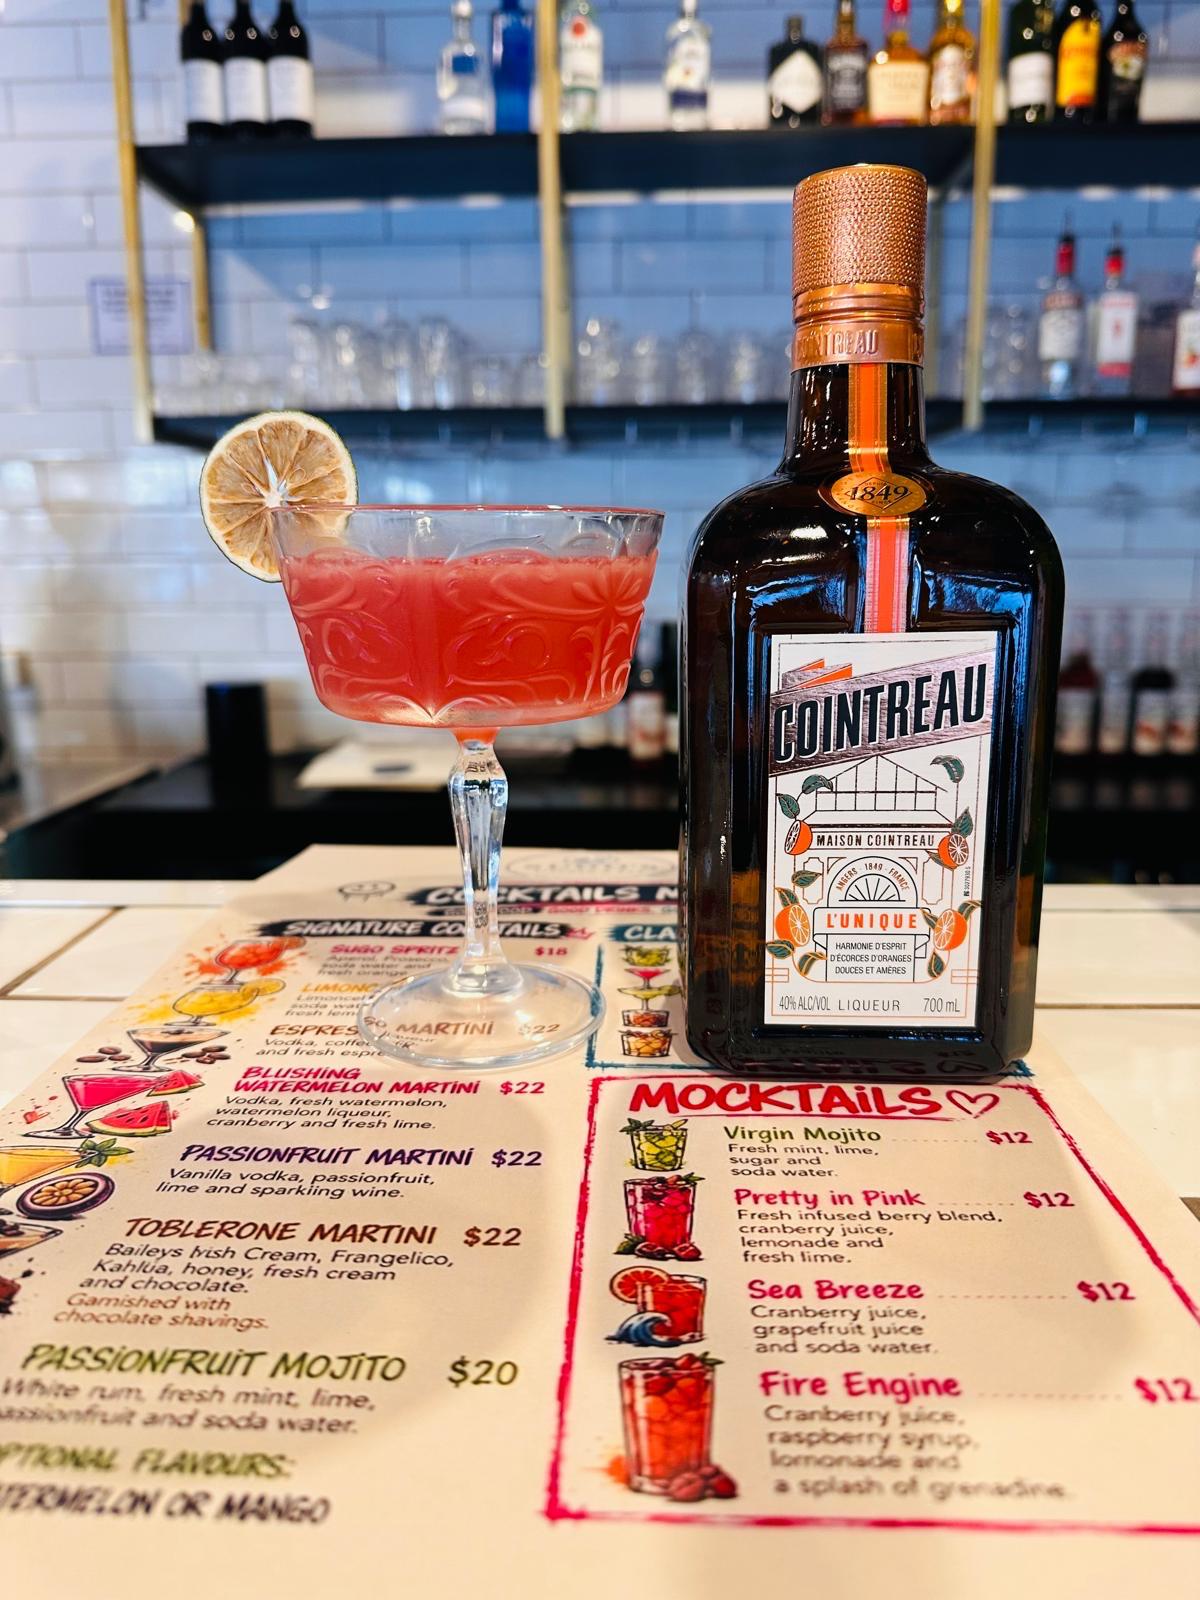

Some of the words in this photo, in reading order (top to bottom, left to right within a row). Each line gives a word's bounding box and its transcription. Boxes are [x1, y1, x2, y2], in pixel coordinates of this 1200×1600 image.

[849, 484, 909, 501] 1849
[773, 663, 987, 763] COINTREAU
[816, 834, 862, 847] MAISON
[867, 834, 935, 847] COINTREAU
[836, 867, 858, 891] ANGERS
[864, 863, 883, 871] 1849
[888, 868, 911, 891] FRANCE
[283, 920, 424, 936] SIGNATURE
[430, 922, 561, 938] COTAILS
[826, 912, 917, 931] L'UNIQUE
[330, 944, 384, 954] SUGO
[390, 944, 460, 955] SPRITZ
[534, 946, 568, 957] $18
[835, 942, 873, 951] HARMONIE
[875, 942, 907, 951] D'ESPRIT
[830, 953, 869, 963] D'ÉCORCES
[870, 954, 912, 963] D'ORANGES
[835, 966, 864, 974] DOUCES
[865, 966, 875, 974] ET
[876, 964, 907, 974] AMÈRES
[302, 983, 380, 993] LIMONC
[779, 996, 797, 1011] 40%
[797, 996, 831, 1011] ALC/VOL
[838, 999, 900, 1012] LIQUEUR
[923, 997, 943, 1012] 700
[945, 998, 960, 1012] mL
[256, 1048, 291, 1056] and
[293, 1048, 336, 1056] fresh
[233, 1080, 384, 1095] WATERMELON
[500, 1081, 545, 1096] $22
[225, 1095, 283, 1108] Vodka,
[289, 1096, 332, 1108] fresh
[336, 1097, 447, 1109] watermelon,
[214, 1107, 322, 1119] watermelon
[327, 1107, 392, 1120] liqueur,
[206, 1117, 295, 1131] cranberry
[301, 1118, 336, 1130] and
[342, 1118, 387, 1130] fresh
[391, 1119, 437, 1131] lime.
[723, 1125, 795, 1145] Virgin
[803, 1126, 882, 1144] Mojito
[985, 1129, 1033, 1146] $12
[491, 1147, 543, 1168] $22
[727, 1143, 778, 1156] Fresh
[783, 1145, 829, 1157] mint,
[834, 1145, 879, 1157] lime,
[729, 1156, 780, 1169] sugar
[786, 1156, 821, 1167] and
[168, 1167, 232, 1181] Vanilla
[237, 1169, 305, 1184] vodka,
[311, 1171, 436, 1188] passionfruit,
[731, 1167, 774, 1178] soda
[779, 1168, 838, 1178] water.
[155, 1181, 201, 1194] lime
[206, 1182, 245, 1195] and
[350, 1186, 405, 1199] wine.
[733, 1188, 820, 1210] Pretty
[828, 1189, 853, 1206] in
[862, 1189, 926, 1207] Pink
[1023, 1190, 1076, 1209] $12
[737, 1208, 792, 1223] Fresh
[798, 1209, 873, 1223] infused
[878, 1210, 932, 1225] berry
[938, 1210, 1003, 1225] blend,
[124, 1217, 301, 1242] TOBLERONE
[463, 1225, 523, 1247] $22
[739, 1222, 834, 1239] cranberry
[840, 1223, 894, 1238] juice,
[740, 1236, 840, 1250] lemonade
[846, 1236, 884, 1250] and
[105, 1242, 184, 1260] Baileys
[244, 1248, 322, 1266] Cream,
[331, 1250, 454, 1270] Frangelico,
[743, 1249, 794, 1264] fresh
[801, 1250, 852, 1264] lime.
[181, 1262, 253, 1280] honey,
[263, 1264, 318, 1280] fresh
[323, 1267, 396, 1282] cream
[78, 1275, 131, 1291] and
[135, 1277, 249, 1294] chocolate.
[747, 1279, 802, 1301] Sea
[816, 1280, 924, 1300] Breeze
[1076, 1280, 1136, 1303] $12
[184, 1296, 231, 1311] with
[53, 1308, 163, 1325] chocolate
[168, 1312, 269, 1332] shavings.
[750, 1305, 861, 1323] Cranberry
[866, 1306, 926, 1324] juice,
[753, 1321, 866, 1342] grapefruit
[870, 1322, 925, 1341] juice
[754, 1340, 799, 1355] and
[806, 1340, 860, 1355] soda
[866, 1340, 937, 1355] water.
[446, 1355, 519, 1388] $20
[2, 1377, 80, 1400] White
[158, 1384, 226, 1404] fresh
[311, 1389, 377, 1412] lime,
[760, 1370, 829, 1398] Fire
[844, 1371, 963, 1405] Engine
[1134, 1377, 1198, 1402] $12
[143, 1407, 197, 1428] and
[203, 1409, 267, 1430] soda
[277, 1415, 359, 1434] water.
[764, 1404, 889, 1428] Cranberry
[767, 1429, 890, 1451] raspberry
[0, 1440, 118, 1473] PTIONAL
[773, 1479, 790, 1496] a
[798, 1474, 884, 1501] splash
[892, 1473, 923, 1496] of
[165, 1489, 212, 1518] OR
[215, 1490, 331, 1524] MANGO
